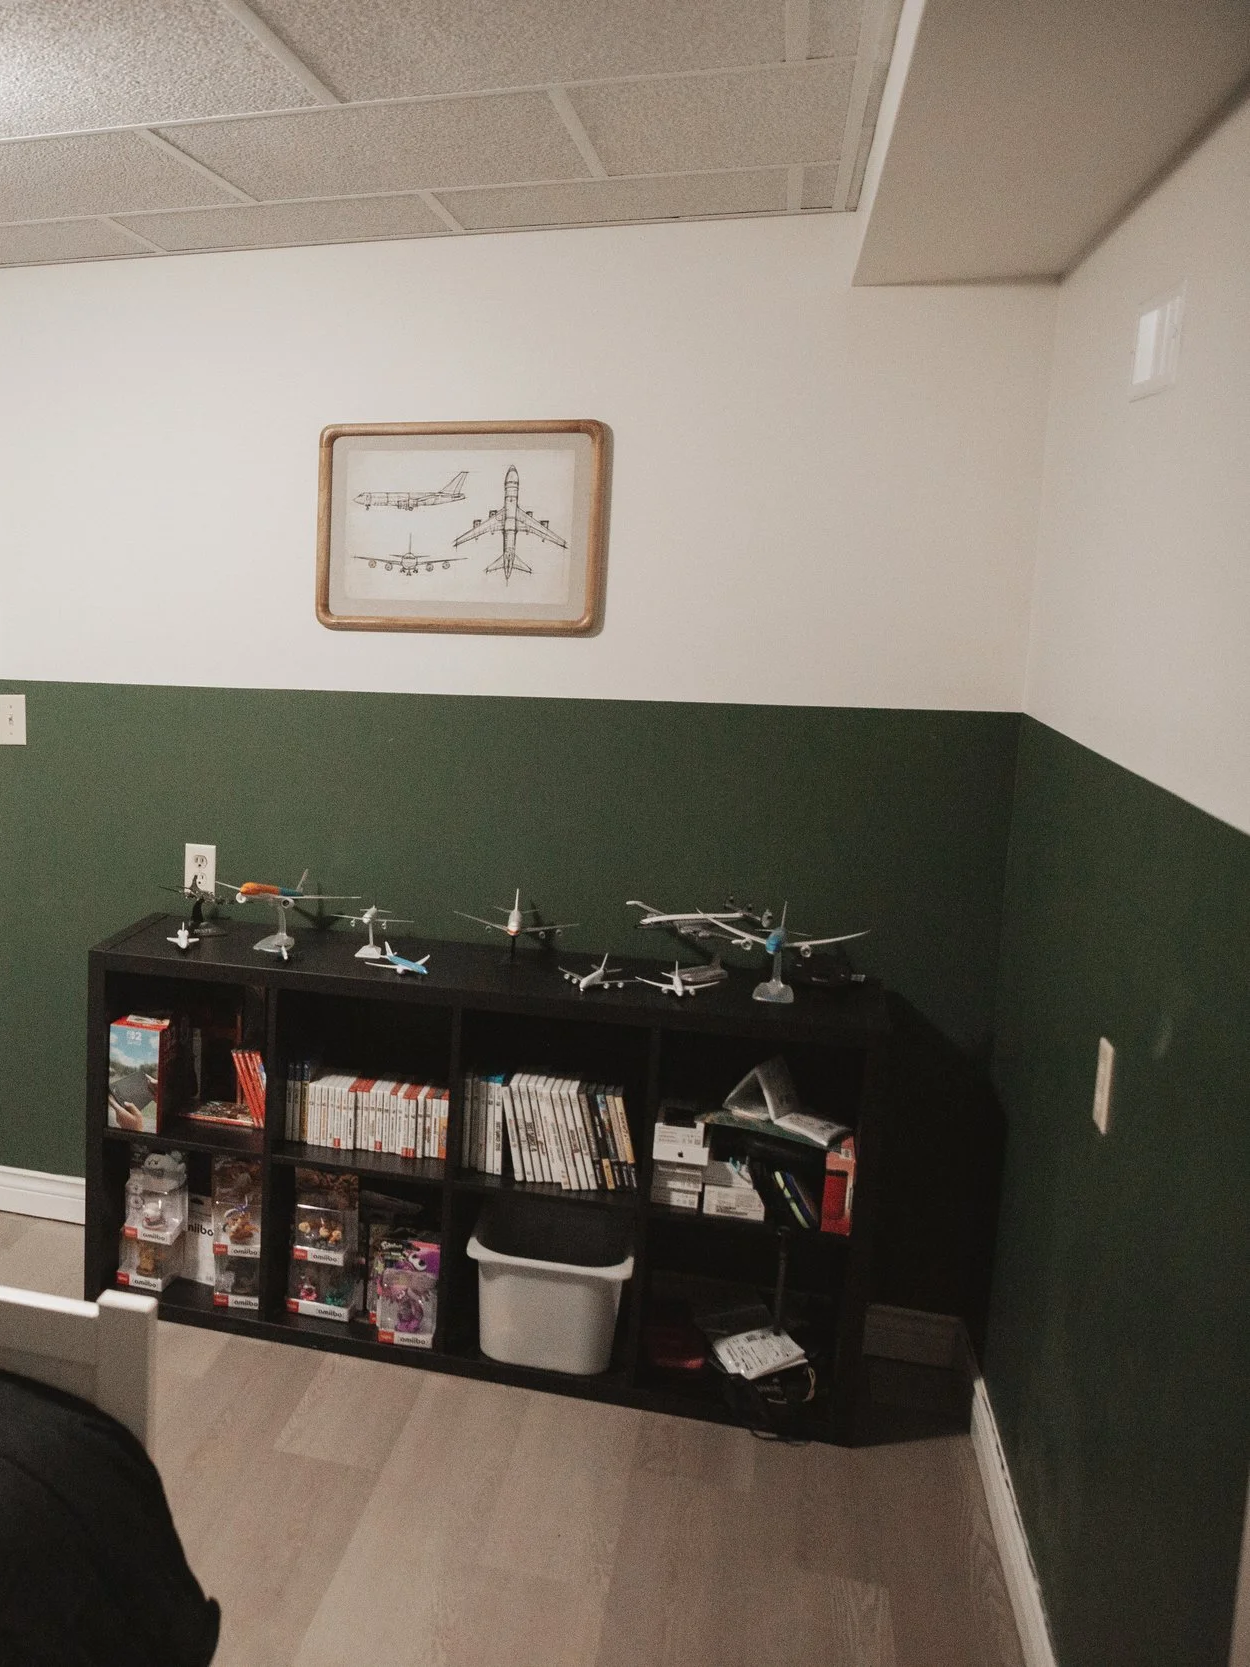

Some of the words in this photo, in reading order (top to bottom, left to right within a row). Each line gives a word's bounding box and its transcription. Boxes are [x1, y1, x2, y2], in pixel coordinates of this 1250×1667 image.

[312, 1254, 337, 1262] amiibo
[134, 1279, 157, 1288] amiibo
[318, 1309, 343, 1318] amiibo
